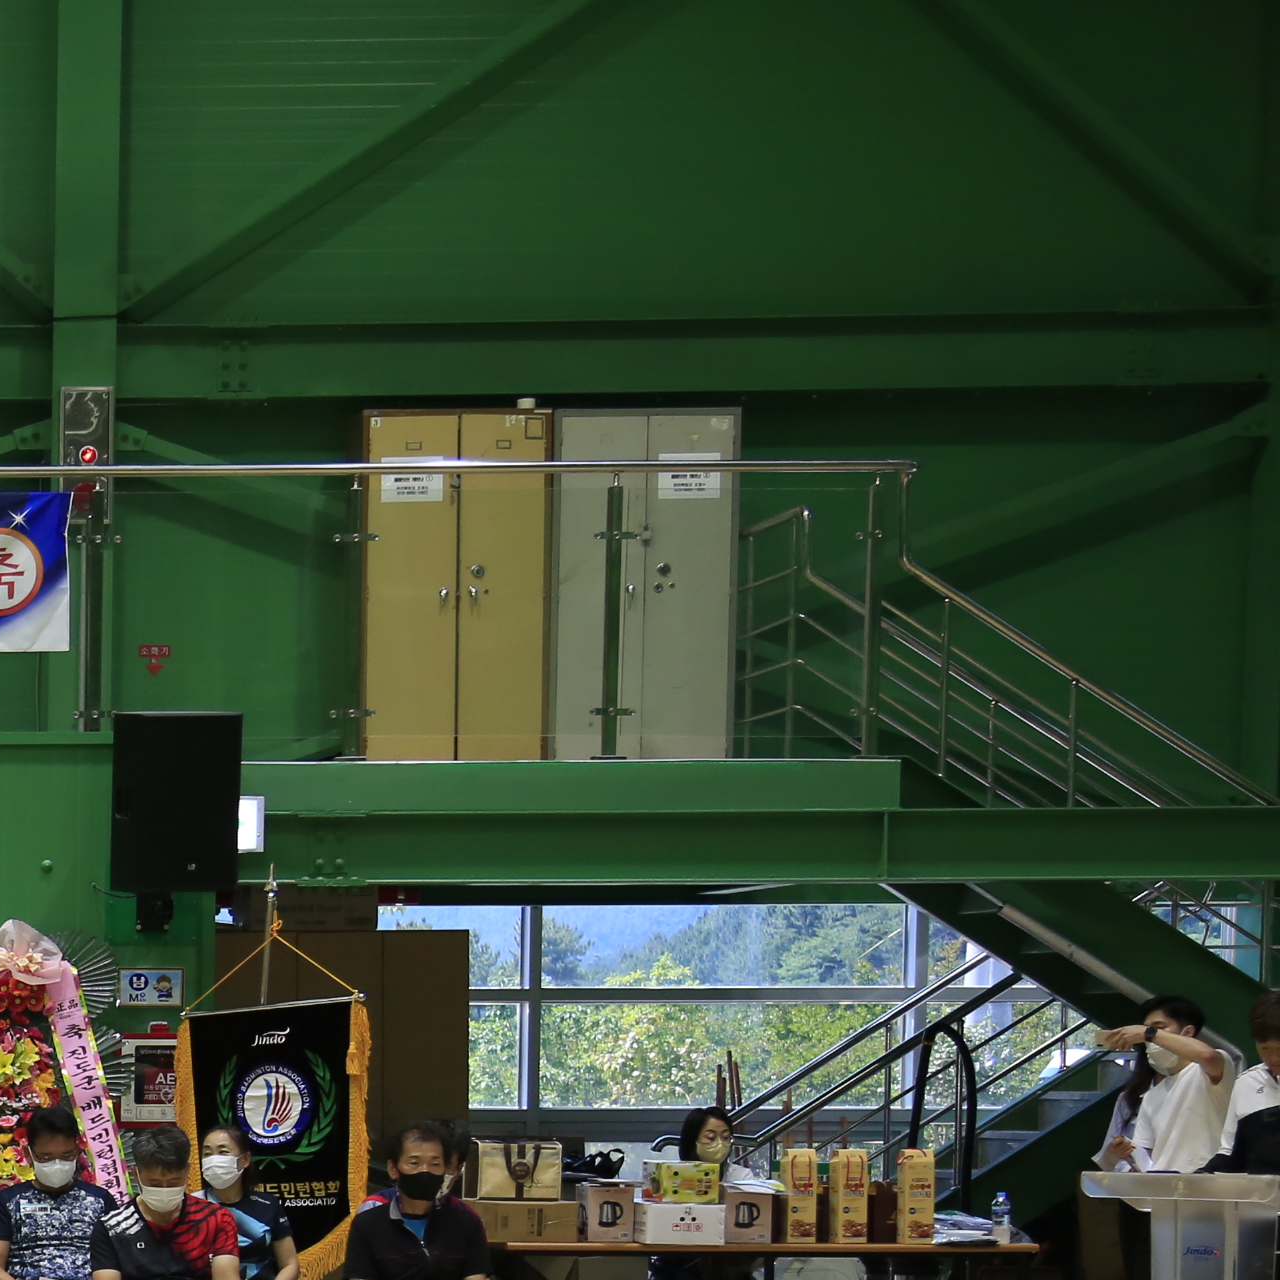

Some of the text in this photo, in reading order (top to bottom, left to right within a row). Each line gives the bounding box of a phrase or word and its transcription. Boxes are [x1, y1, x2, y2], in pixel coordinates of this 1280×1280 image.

[140, 646, 169, 656] 소화기
[132, 976, 146, 988] 남
[61, 1023, 87, 1039] 축
[252, 1030, 287, 1046] Jindo
[65, 1045, 100, 1091] 진도군
[155, 1073, 176, 1084] AE
[241, 1065, 276, 1092] BADMINTON
[278, 1067, 310, 1108] ASSOCIATION
[1183, 1246, 1215, 1256] Jindo
